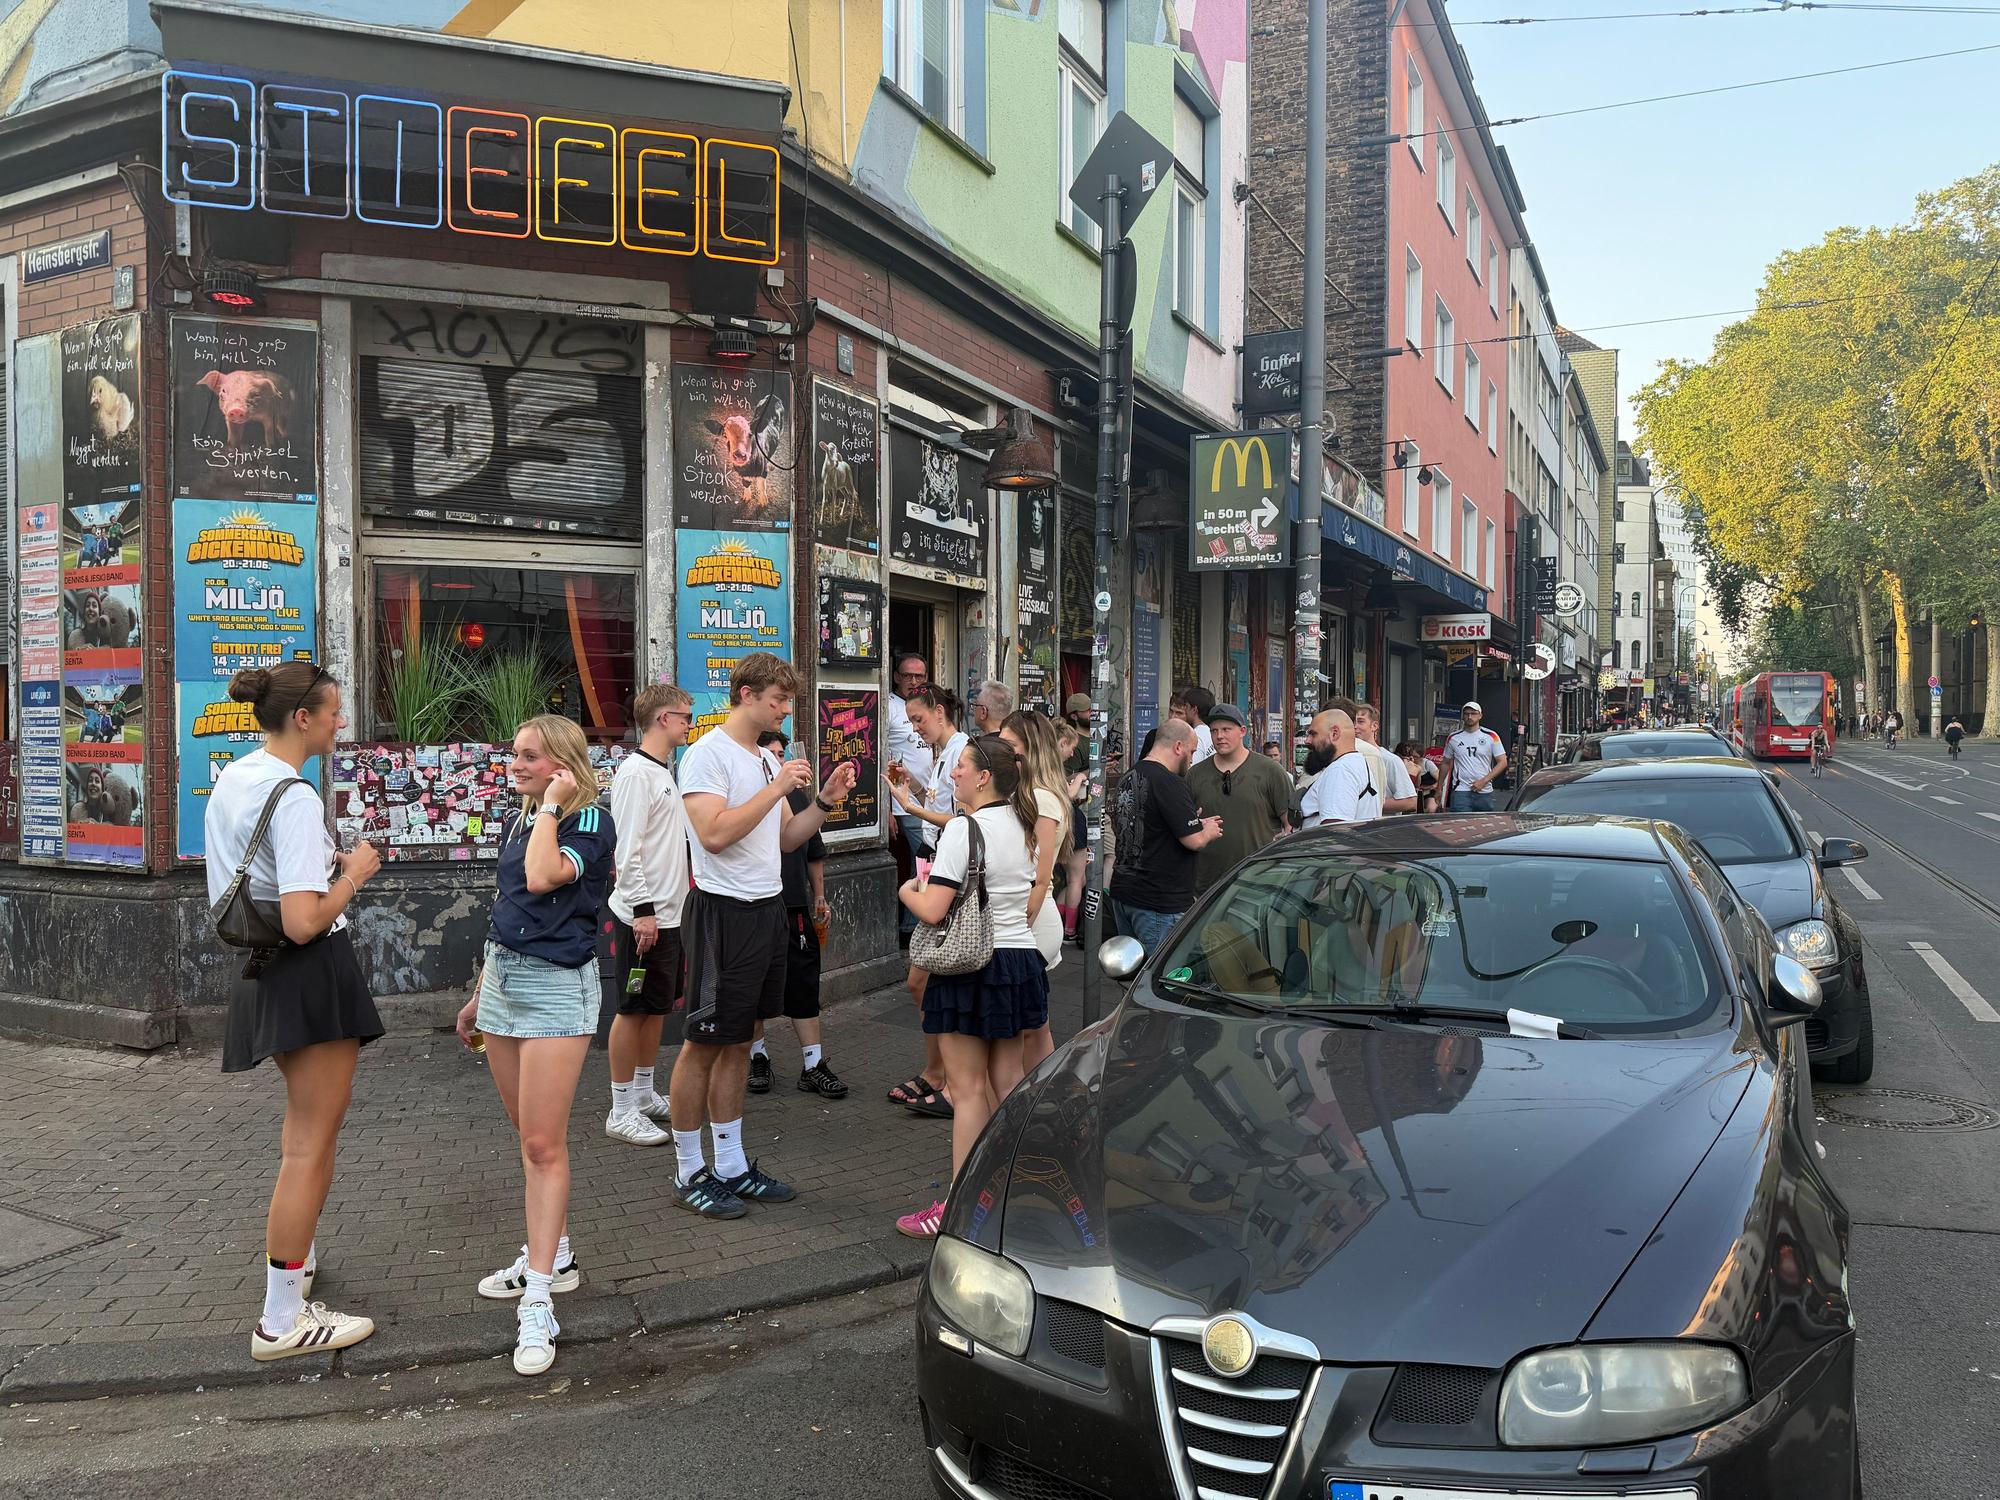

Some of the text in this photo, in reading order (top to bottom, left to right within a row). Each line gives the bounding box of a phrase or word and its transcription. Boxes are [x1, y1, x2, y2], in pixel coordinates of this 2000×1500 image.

[181, 91, 767, 247] STIEFEL
[28, 239, 100, 274] Heinsbergstr.
[64, 341, 85, 355] Wenn
[186, 331, 287, 353] Wenn ich groß
[101, 355, 112, 370] ich
[194, 348, 276, 366] bin, will ich
[680, 374, 757, 394] Wenn ich groß
[714, 393, 733, 406] will
[737, 396, 751, 411] ich
[69, 433, 96, 465] Nugget
[694, 449, 718, 466] kein
[233, 465, 299, 483] werden.
[683, 461, 739, 489] Steak
[690, 489, 739, 504] werden.
[1204, 509, 1247, 520] in 50 m
[199, 529, 295, 546] SOMMERGARTEN
[187, 540, 304, 564] BICKENDORF
[934, 533, 968, 560] Stiefel
[222, 559, 271, 570] 20.-21.06.
[696, 556, 773, 570] SOMMERGARTEN
[1196, 552, 1283, 565] Barbrossaplatz 1
[64, 576, 85, 585] DENNIS
[686, 566, 781, 588] BICKENDORF
[205, 585, 285, 610] MILJÖ
[1018, 584, 1033, 598] LIVE
[276, 608, 299, 618] LIVE
[1018, 598, 1050, 615] FUSSBALL
[701, 606, 766, 629] MILJÖ
[1019, 612, 1032, 626] WM
[759, 627, 778, 635] LIVE
[1442, 625, 1485, 637] KIOSK
[212, 643, 282, 654] EINTRITT FREI
[213, 656, 228, 667] 14
[239, 656, 254, 667] 22
[258, 656, 281, 667] UHR
[708, 670, 720, 679] 14
[204, 702, 255, 716] SOMMER
[826, 728, 843, 744] SEX
[66, 750, 88, 758] DENNIS
[832, 739, 865, 761] PISTOLS
[1466, 747, 1477, 757] 17
[67, 831, 86, 839] SENTA
[1086, 888, 1100, 920] FACH
